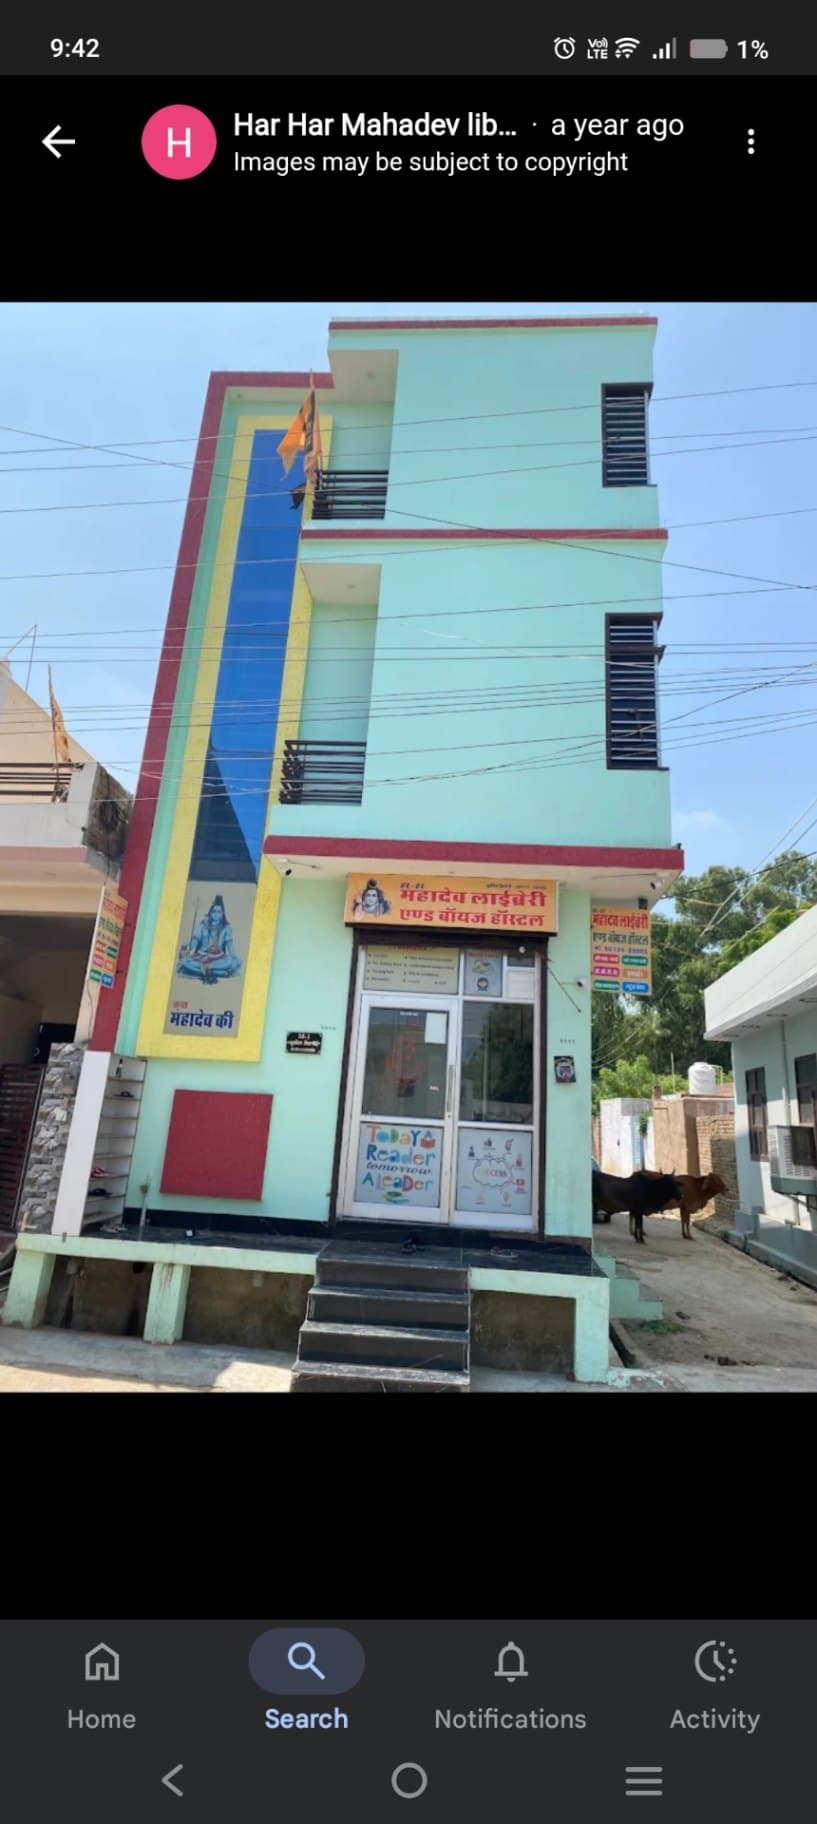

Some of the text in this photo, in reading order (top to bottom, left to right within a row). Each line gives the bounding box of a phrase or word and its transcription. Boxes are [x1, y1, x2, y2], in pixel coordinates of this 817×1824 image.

[400, 888, 546, 907] महादेव लाईब्रेरी
[399, 908, 545, 927] एण्ड बॉयज हॉस्टल
[170, 1009, 234, 1029] महादेव की
[366, 1144, 435, 1166] Reader
[366, 1162, 431, 1174] tomorrow
